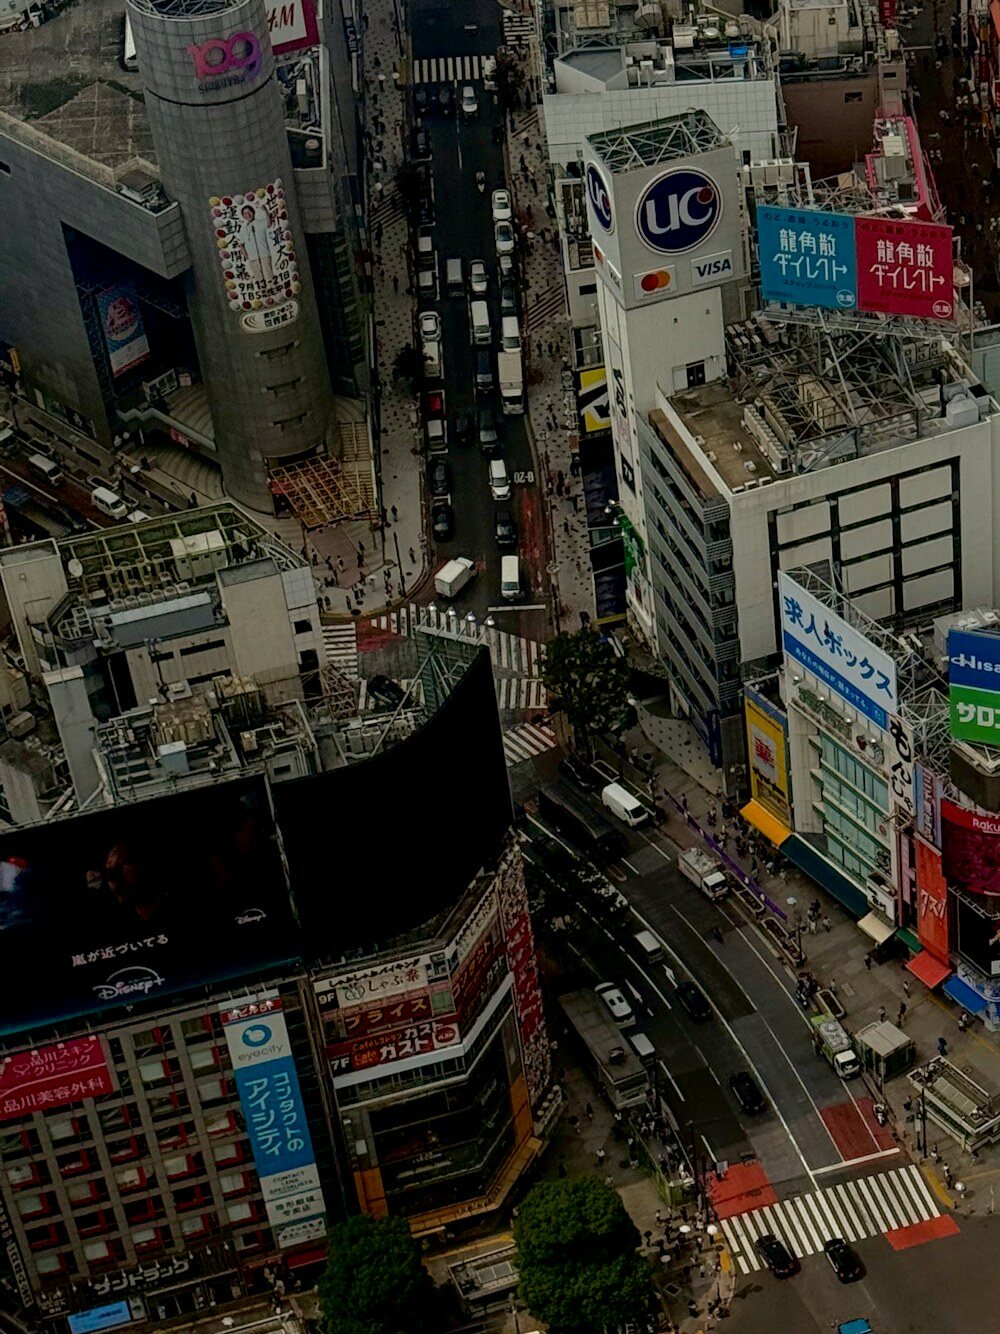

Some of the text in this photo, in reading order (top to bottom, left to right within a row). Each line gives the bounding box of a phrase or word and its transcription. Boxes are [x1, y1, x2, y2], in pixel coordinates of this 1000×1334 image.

[187, 31, 262, 82] 109
[646, 186, 713, 234] UC
[779, 228, 837, 257] 龍角散
[877, 239, 934, 268] 龍角散
[696, 258, 731, 278] VISA
[772, 253, 848, 282] ダイレクト
[870, 264, 946, 292] ダイレクト
[784, 596, 893, 699] 求人ボックス
[71, 934, 169, 967] 嵐が近づいてる
[92, 971, 166, 1000] Disney+
[369, 968, 419, 991] しゃぶ葉
[318, 992, 335, 1005] 9F
[30, 1043, 95, 1066] 品川スキン
[238, 1043, 284, 1062] eyecity
[331, 1056, 350, 1071] 7F
[380, 1038, 429, 1060] ガスト
[34, 1055, 90, 1076] クリニック
[4, 1077, 104, 1113] 品川美容外科
[244, 1077, 282, 1156] アイシティ
[272, 1071, 304, 1152] コンタクトの
